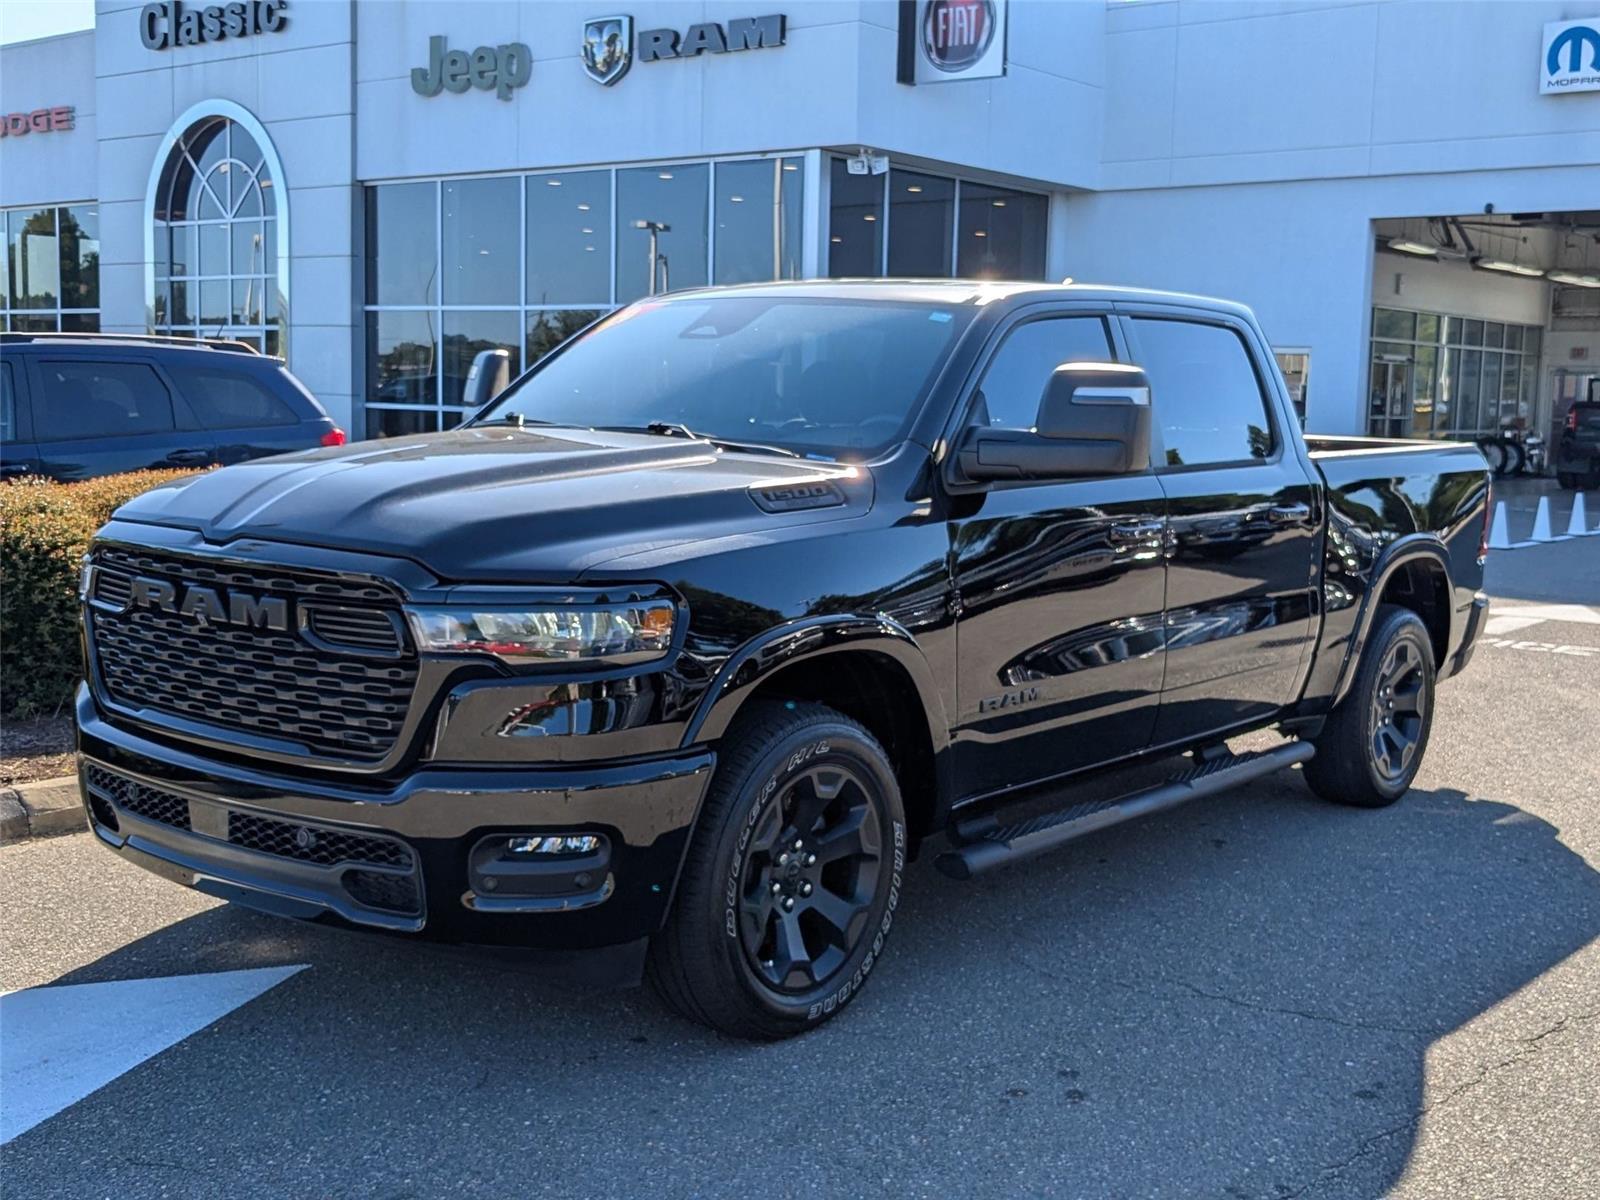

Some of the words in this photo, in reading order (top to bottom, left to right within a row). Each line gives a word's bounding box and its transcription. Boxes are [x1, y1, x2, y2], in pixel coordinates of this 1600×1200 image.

[140, 0, 288, 50] Classic
[638, 14, 787, 62] RAM
[937, 4, 979, 48] FIAT
[411, 35, 533, 101] Jeep
[0, 106, 76, 137] DGE
[764, 485, 830, 501] 1500
[134, 576, 288, 631] RAM
[978, 687, 1040, 714] RAM
[726, 774, 778, 938] DUELER
[807, 820, 905, 1020] BRIDGESTONE
